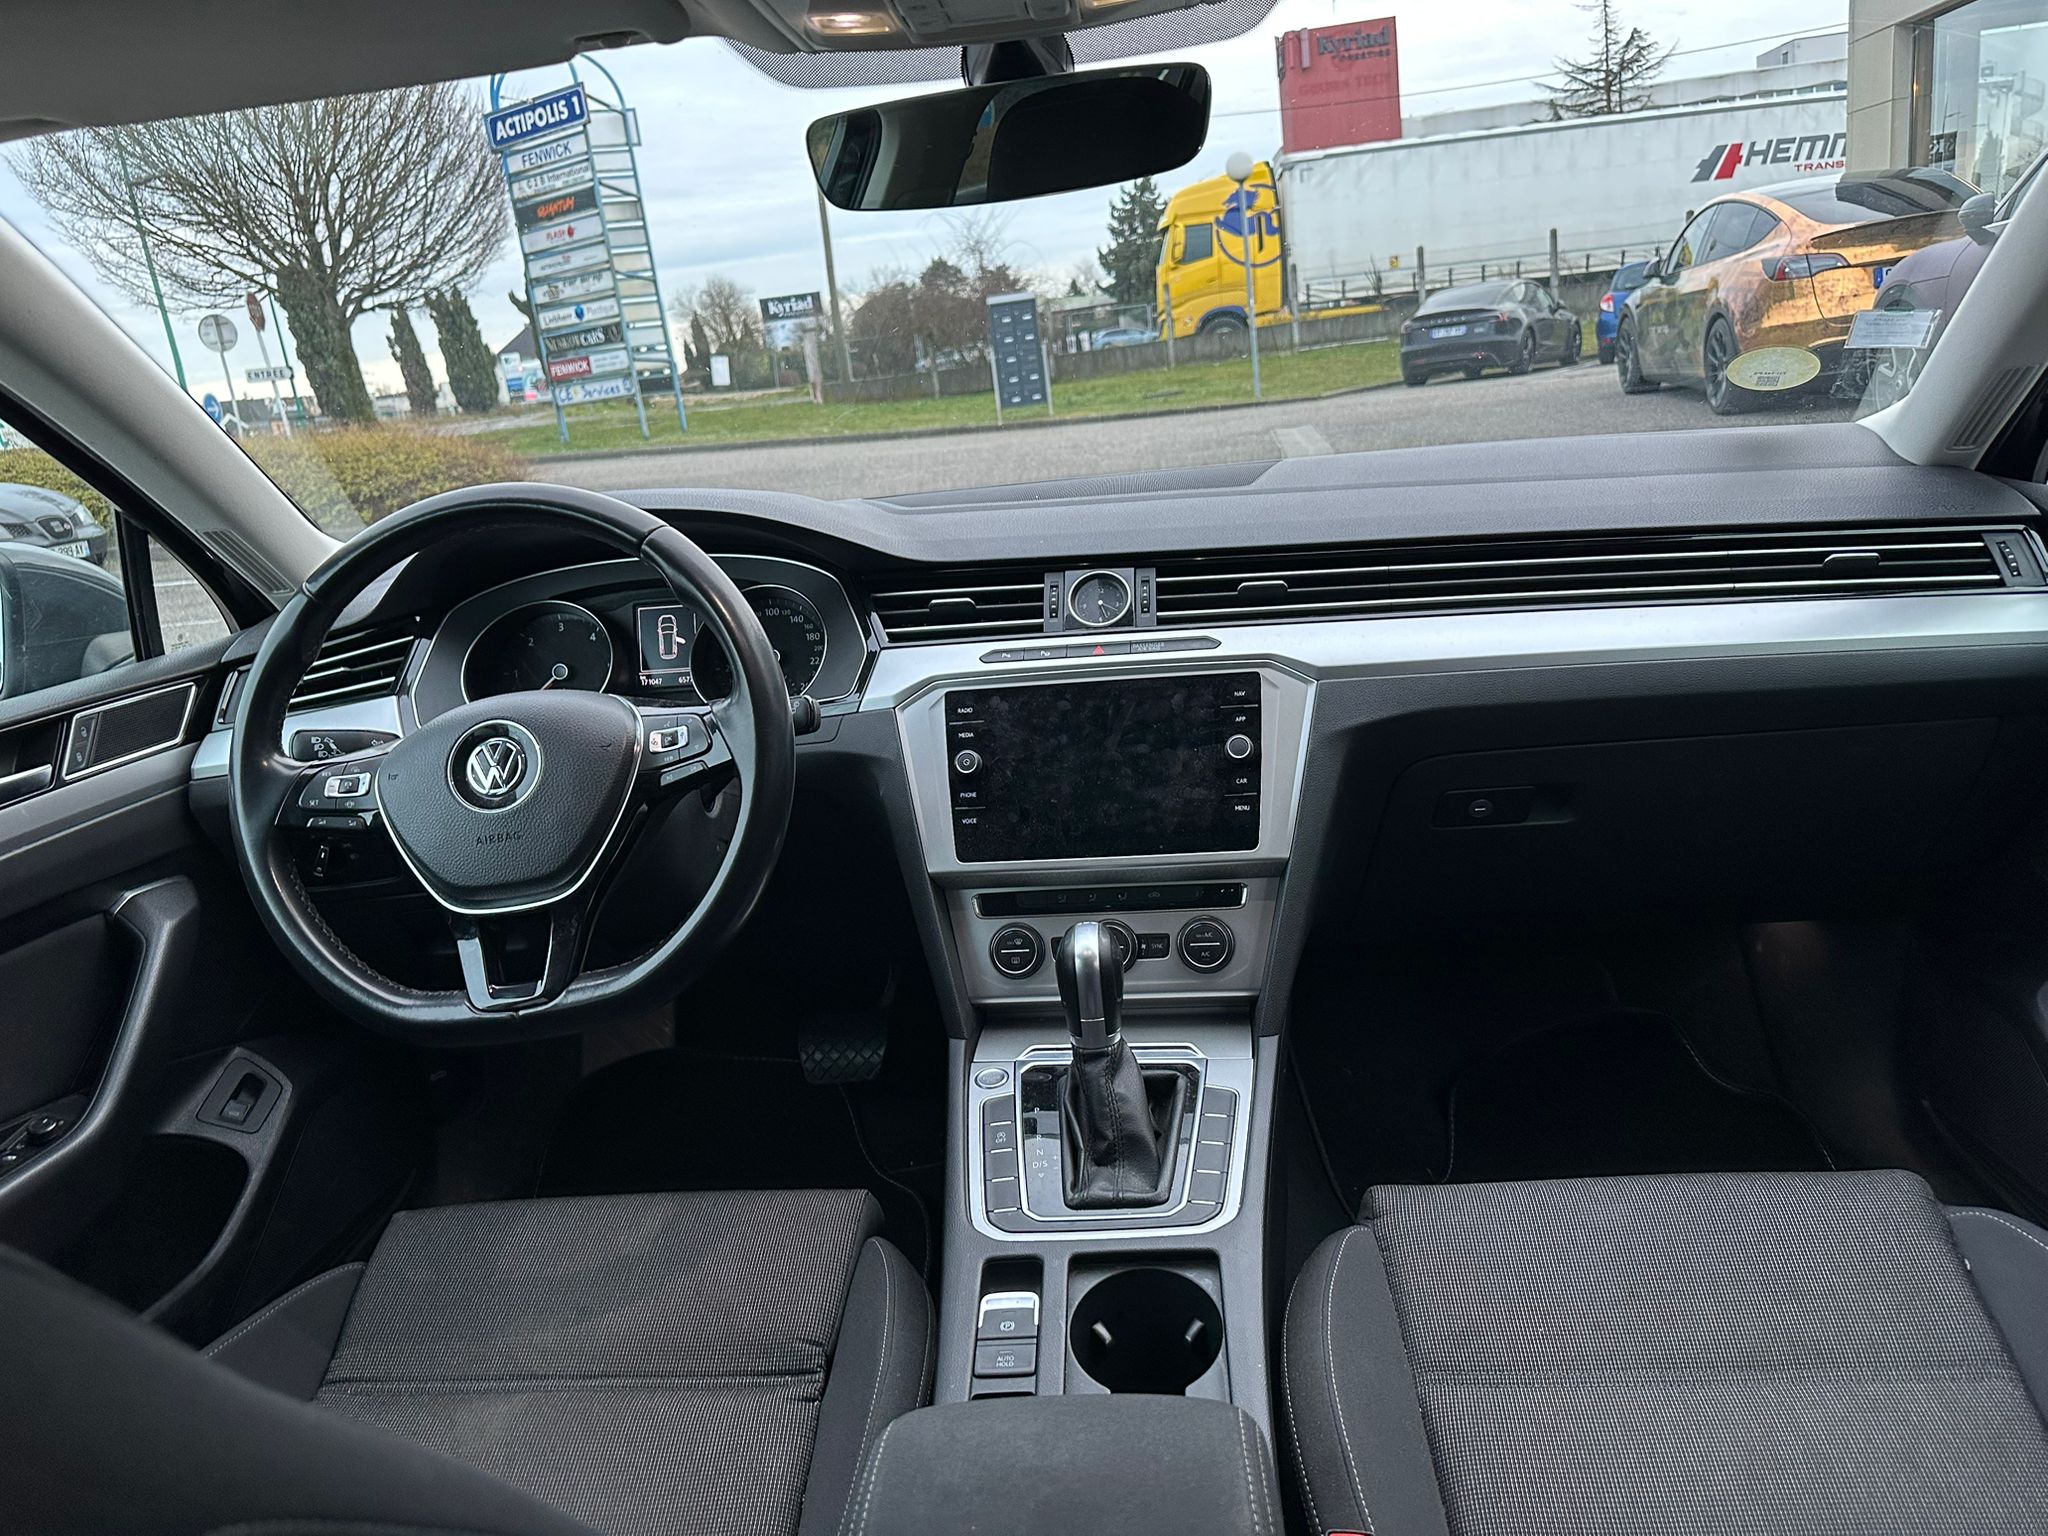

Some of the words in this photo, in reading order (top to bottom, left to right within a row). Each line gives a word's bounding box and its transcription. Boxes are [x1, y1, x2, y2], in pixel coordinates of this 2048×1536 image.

[1317, 25, 1389, 55] Kyriad
[496, 99, 569, 141] ACTIPOLIS
[571, 95, 581, 116] 1
[521, 141, 572, 168] FENWICK
[1794, 160, 1845, 172] TRANS
[767, 294, 814, 317] Kyriad
[551, 360, 590, 377] FENWICK
[765, 607, 780, 616] 100
[789, 615, 804, 623] 140
[558, 622, 564, 632] 3
[528, 637, 535, 647] 2
[589, 632, 596, 641] 4
[805, 632, 820, 641] 180
[475, 830, 522, 847] AIRBAG
[1032, 1160, 1049, 1169] D/S
